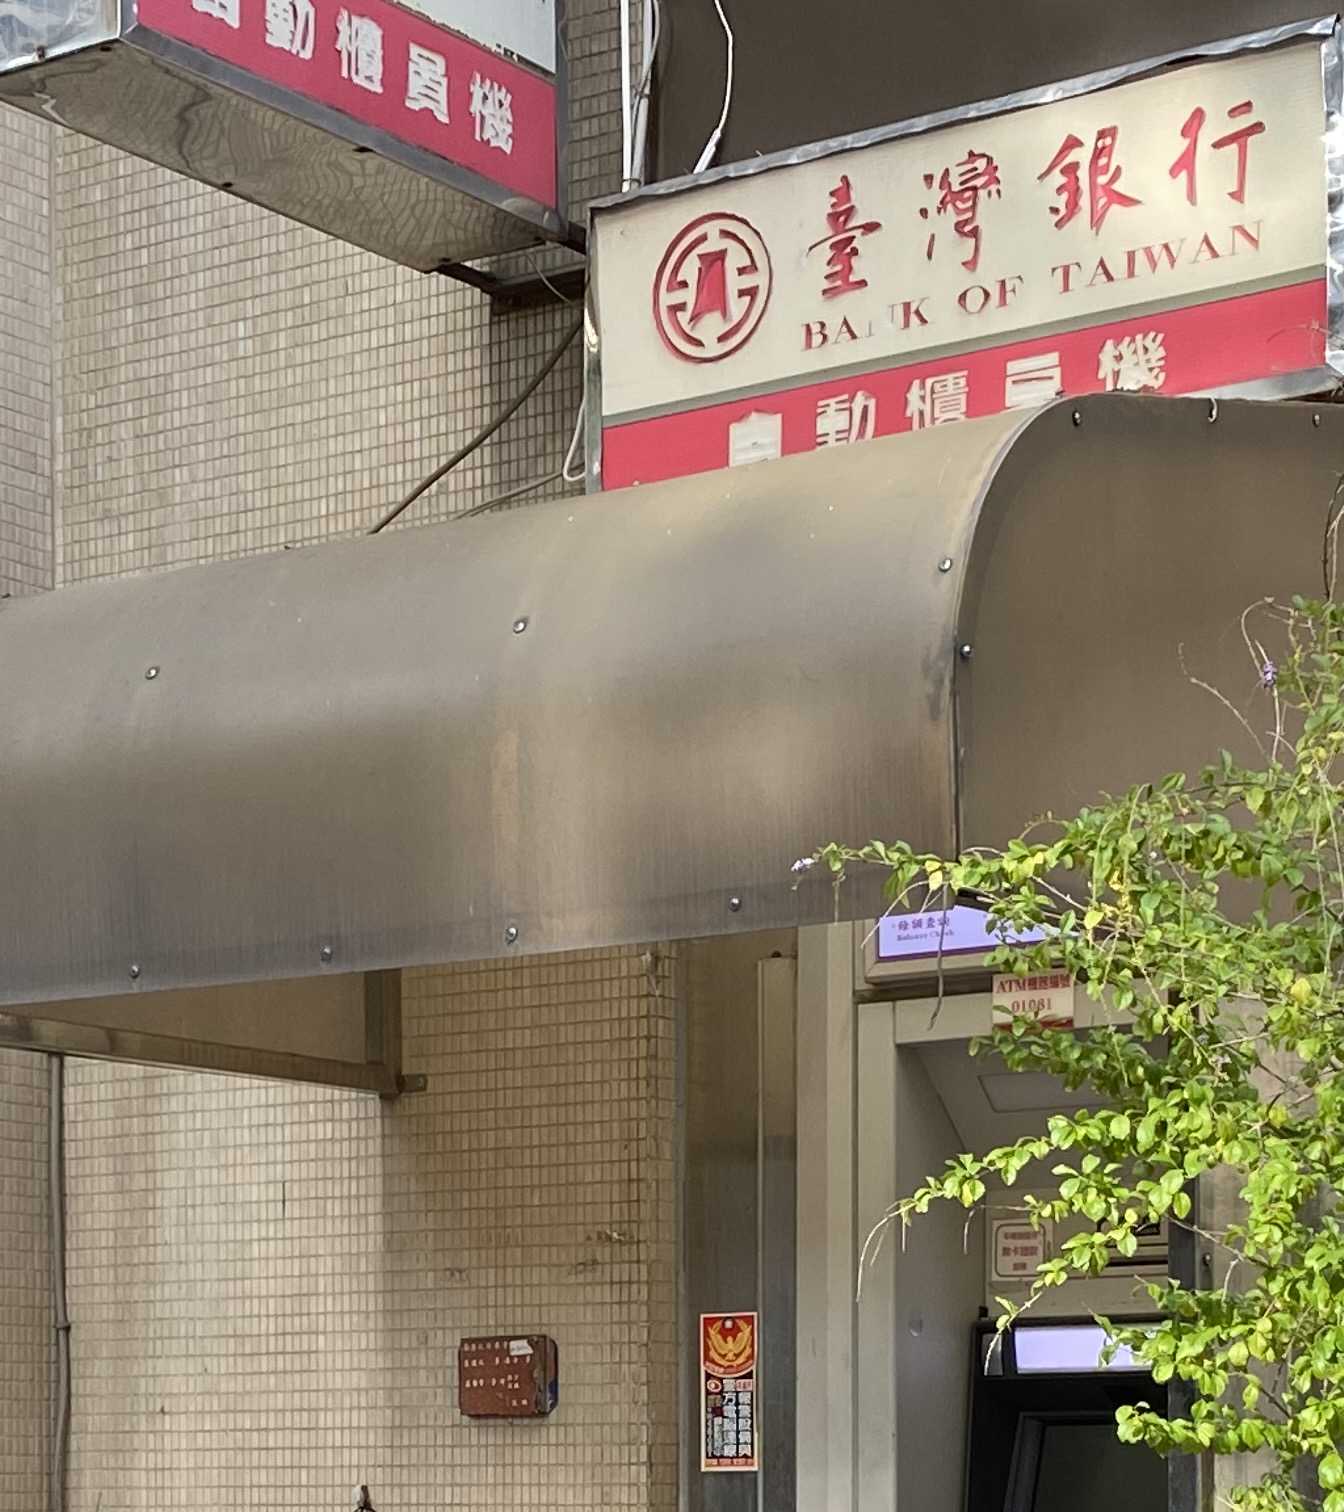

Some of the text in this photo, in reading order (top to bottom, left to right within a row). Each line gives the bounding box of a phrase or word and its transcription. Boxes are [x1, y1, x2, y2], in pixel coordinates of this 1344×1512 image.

[192, 0, 513, 155] 動櫃員機
[808, 101, 1265, 299] 臺灣銀行
[957, 275, 1024, 317] OF
[1051, 220, 1265, 295] TAIWAN
